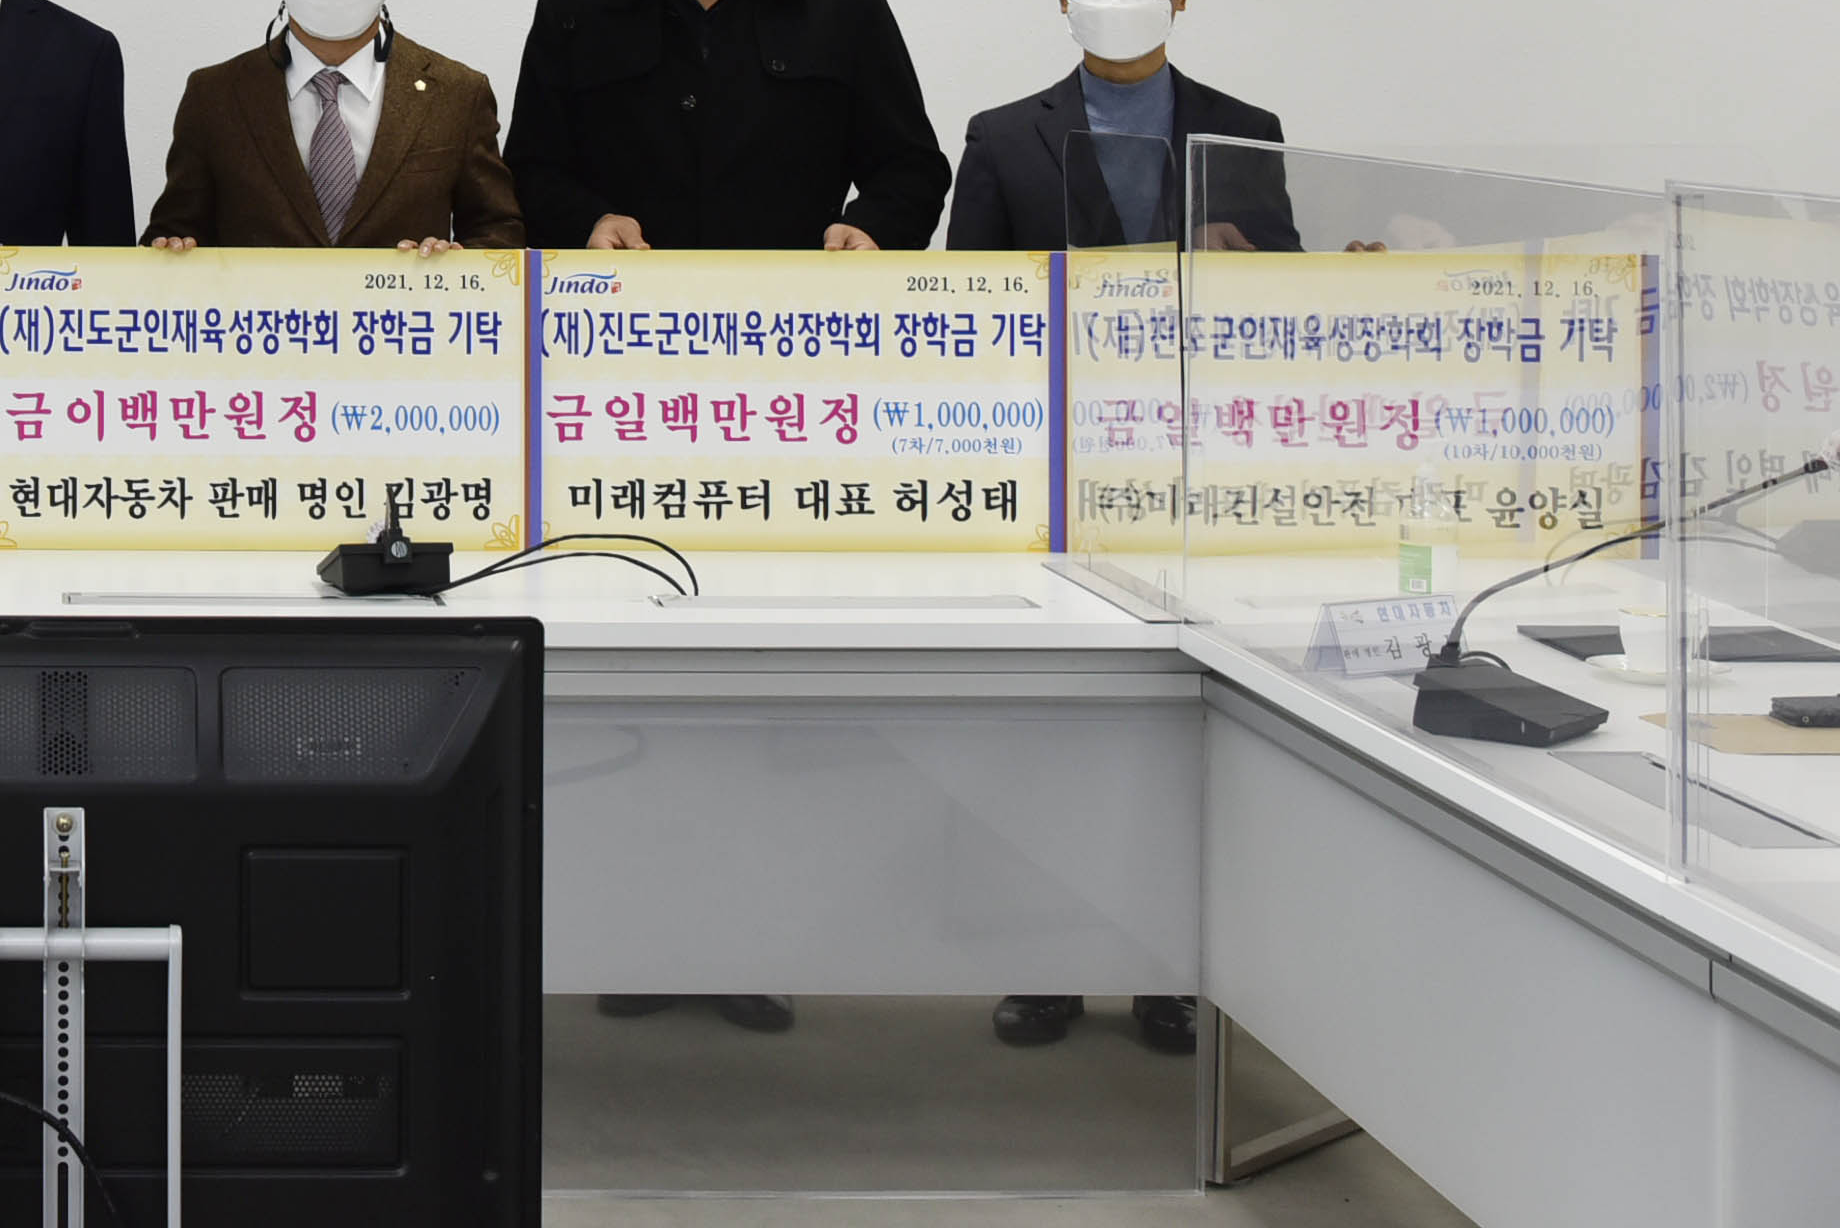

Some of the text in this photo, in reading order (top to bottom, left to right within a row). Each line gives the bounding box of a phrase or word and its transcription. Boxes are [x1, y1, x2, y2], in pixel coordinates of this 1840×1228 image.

[4, 272, 69, 291] Jindo
[364, 274, 485, 291] 2021. 12. 16.
[545, 275, 609, 295] Jindo
[907, 275, 1029, 293] 2021. 12. 16.
[351, 309, 435, 356] 장학금
[447, 309, 503, 356] 기탁
[540, 308, 1047, 358] (재)진도군인재육성장학회 장학금 기탁
[5, 388, 318, 443] 금이백만원정
[546, 391, 860, 444] 금일백만원정
[9, 476, 494, 521] 현대자동차 판매 명인 김광명
[568, 478, 1019, 524] 미래컴퓨터 대표 허성태
